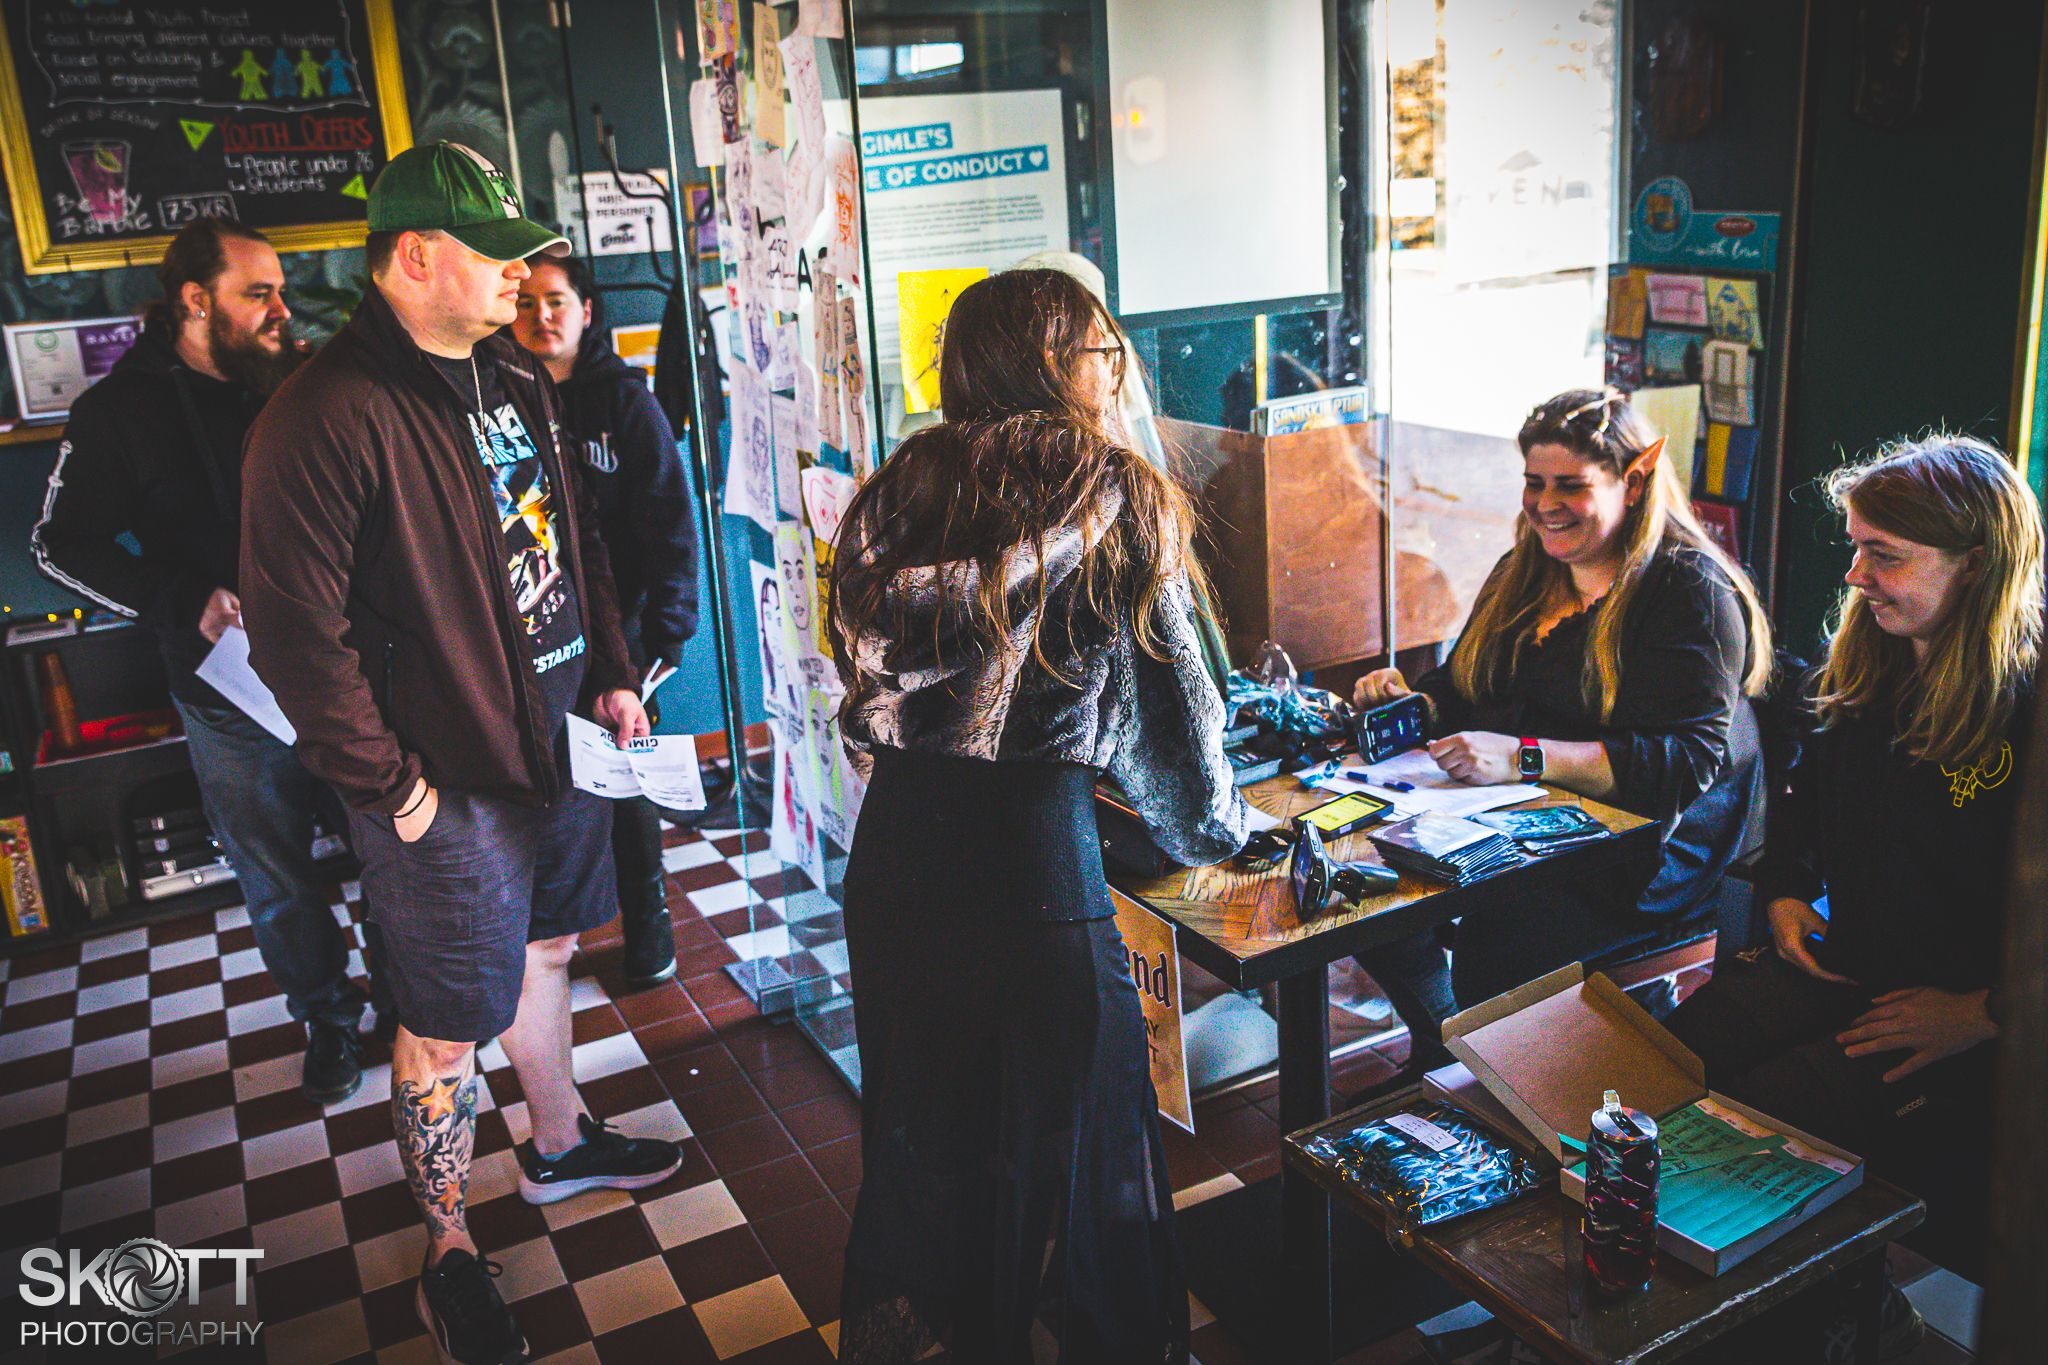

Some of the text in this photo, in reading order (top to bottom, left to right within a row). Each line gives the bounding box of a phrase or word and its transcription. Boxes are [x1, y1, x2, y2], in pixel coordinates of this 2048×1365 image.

[863, 127, 949, 156] GIMLE'S
[886, 166, 917, 186] OF
[921, 152, 1024, 182] CONDUCT
[1131, 949, 1172, 1009] nd
